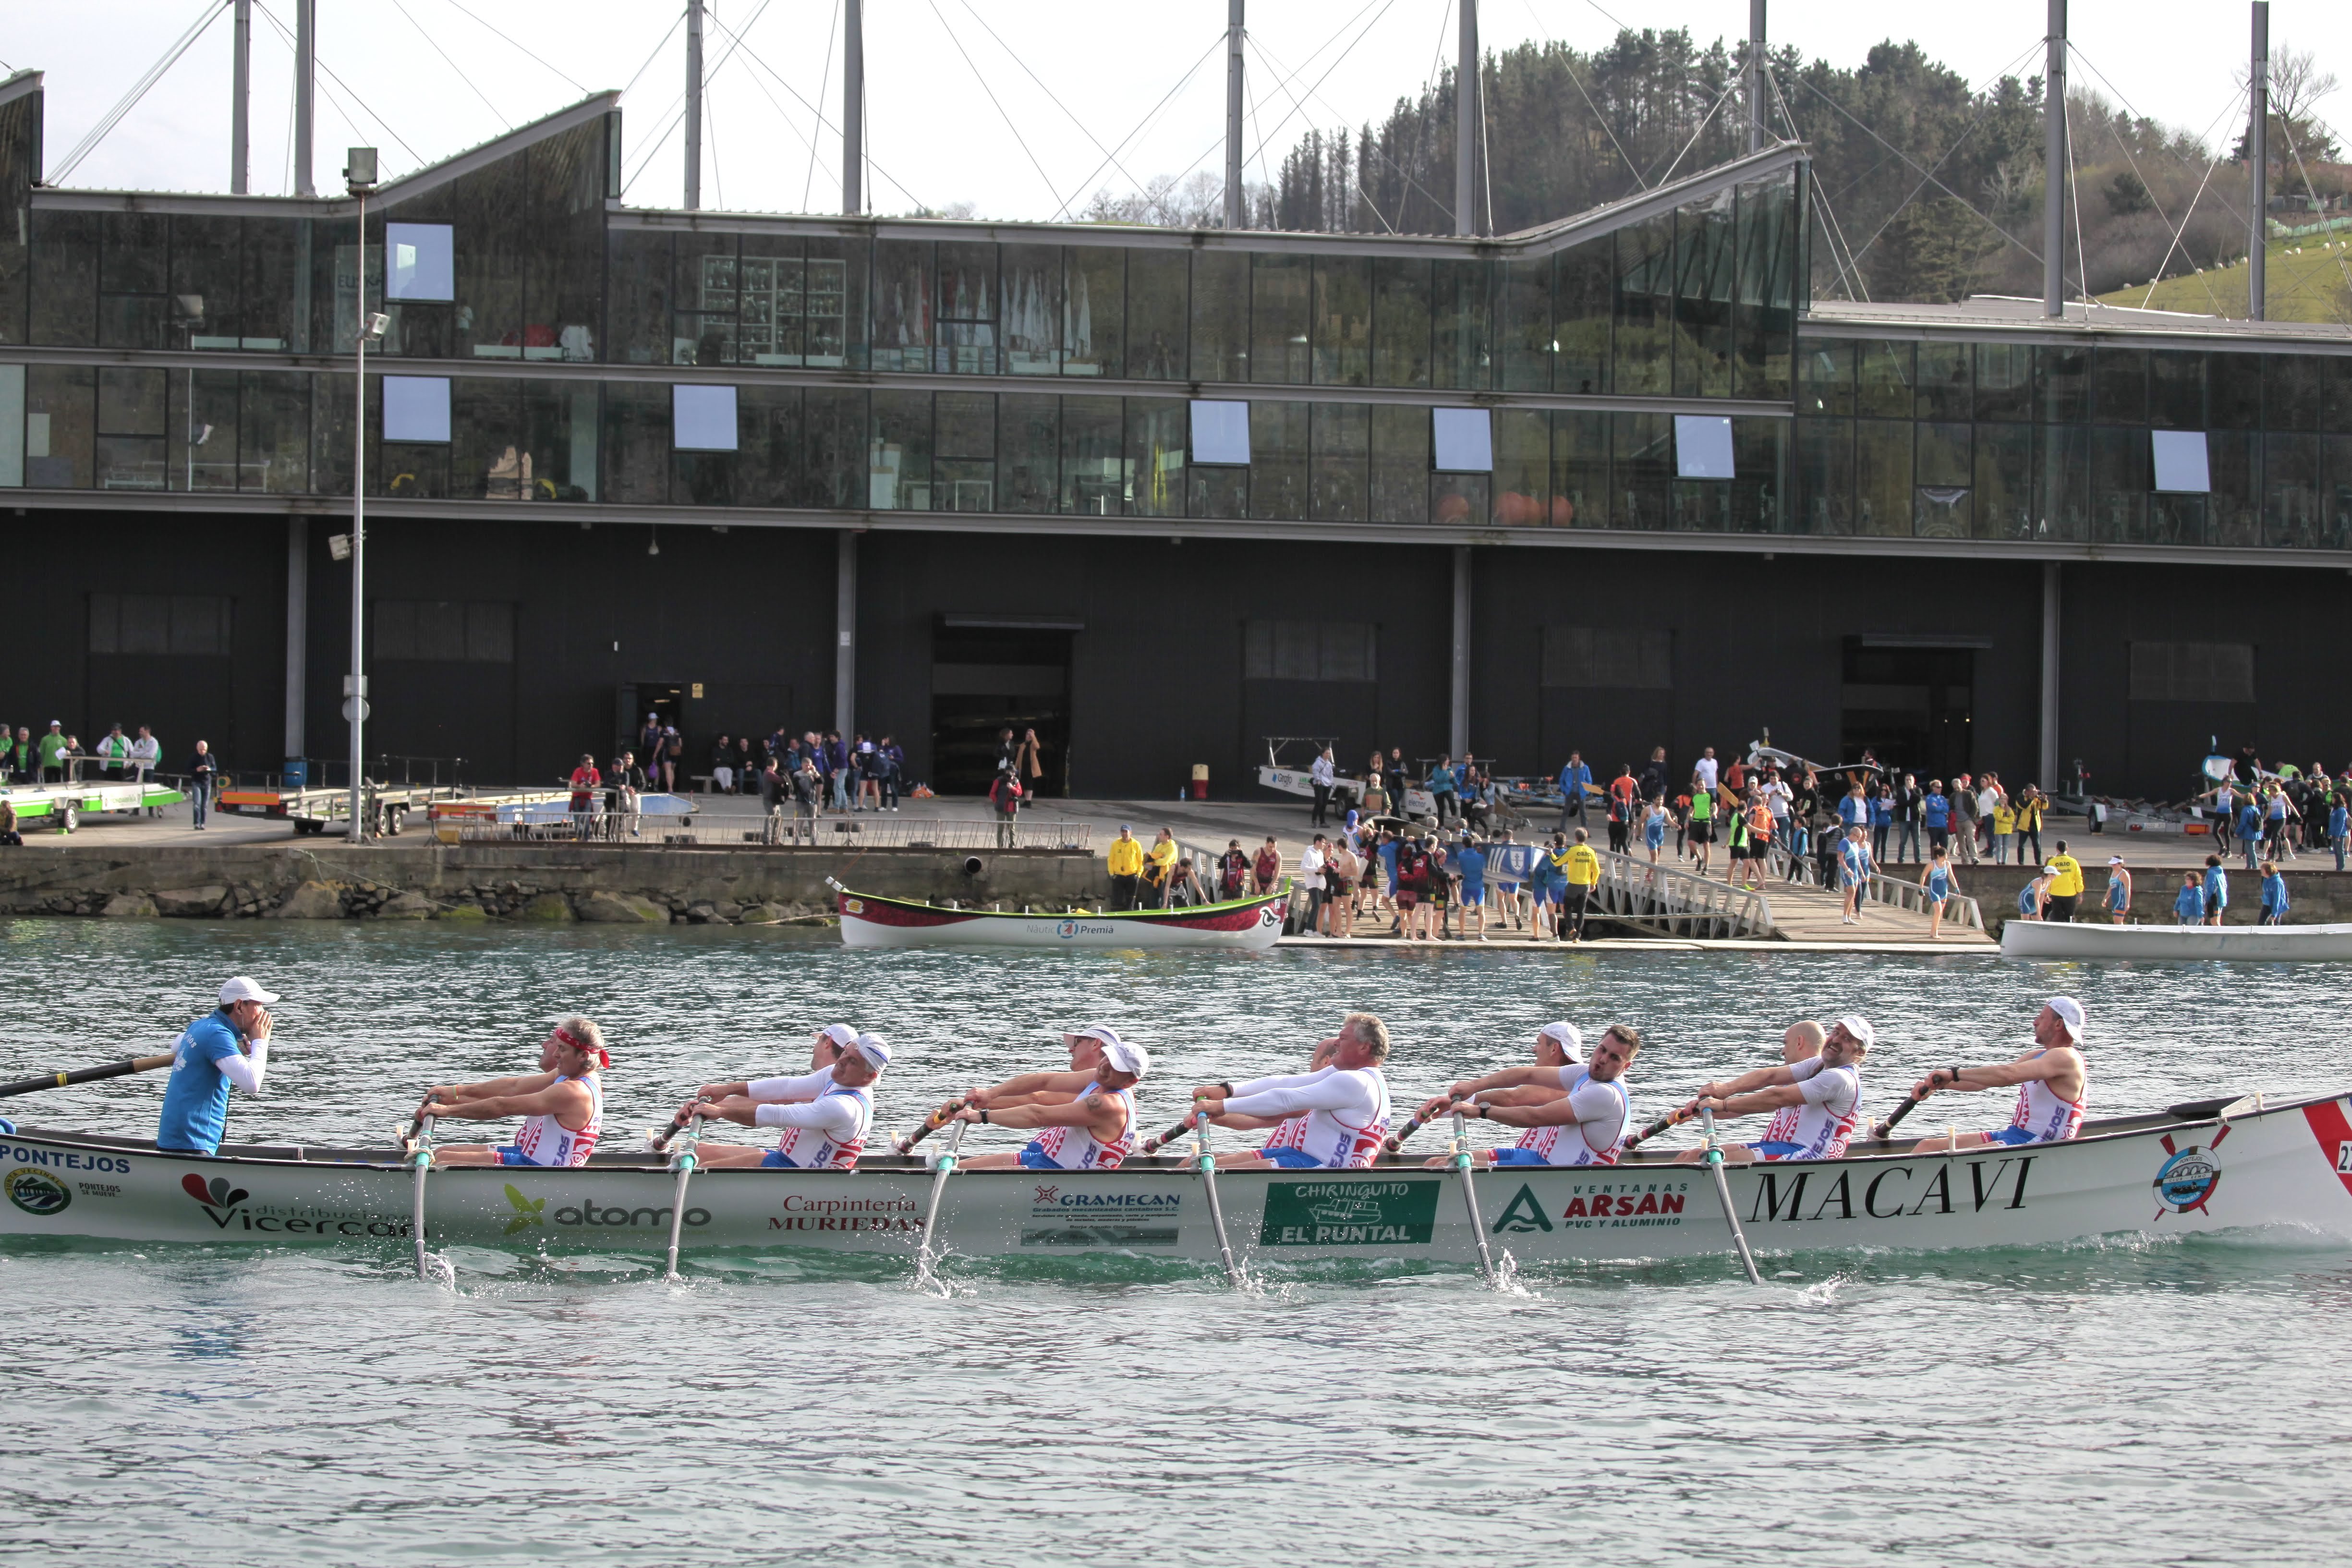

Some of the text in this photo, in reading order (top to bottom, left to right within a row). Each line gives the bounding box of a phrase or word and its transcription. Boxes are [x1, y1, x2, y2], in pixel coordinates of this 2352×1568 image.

[1027, 924, 1114, 934] Nàutic Premià
[0, 1144, 131, 1174] PONTEJOS
[2179, 1156, 2203, 1165] PONTEJOS
[20, 1168, 60, 1183] VECINAL
[79, 1182, 121, 1192] PONTEJOS
[1295, 1183, 1409, 1200] CHIRINGUITO
[1573, 1183, 1688, 1194] VENTANAS
[1745, 1155, 2039, 1223] MACAVI
[783, 1194, 917, 1216] Carpintería
[1060, 1194, 1180, 1206] GRAMECAN
[1563, 1193, 1685, 1218] ARSAN
[256, 1205, 413, 1221] distribucione
[554, 1199, 712, 1226] atomo
[768, 1216, 927, 1231] MURIEDAS
[1565, 1217, 1681, 1228] PVC Y ALUMINIO
[1281, 1225, 1411, 1242] EL PUNTAL
